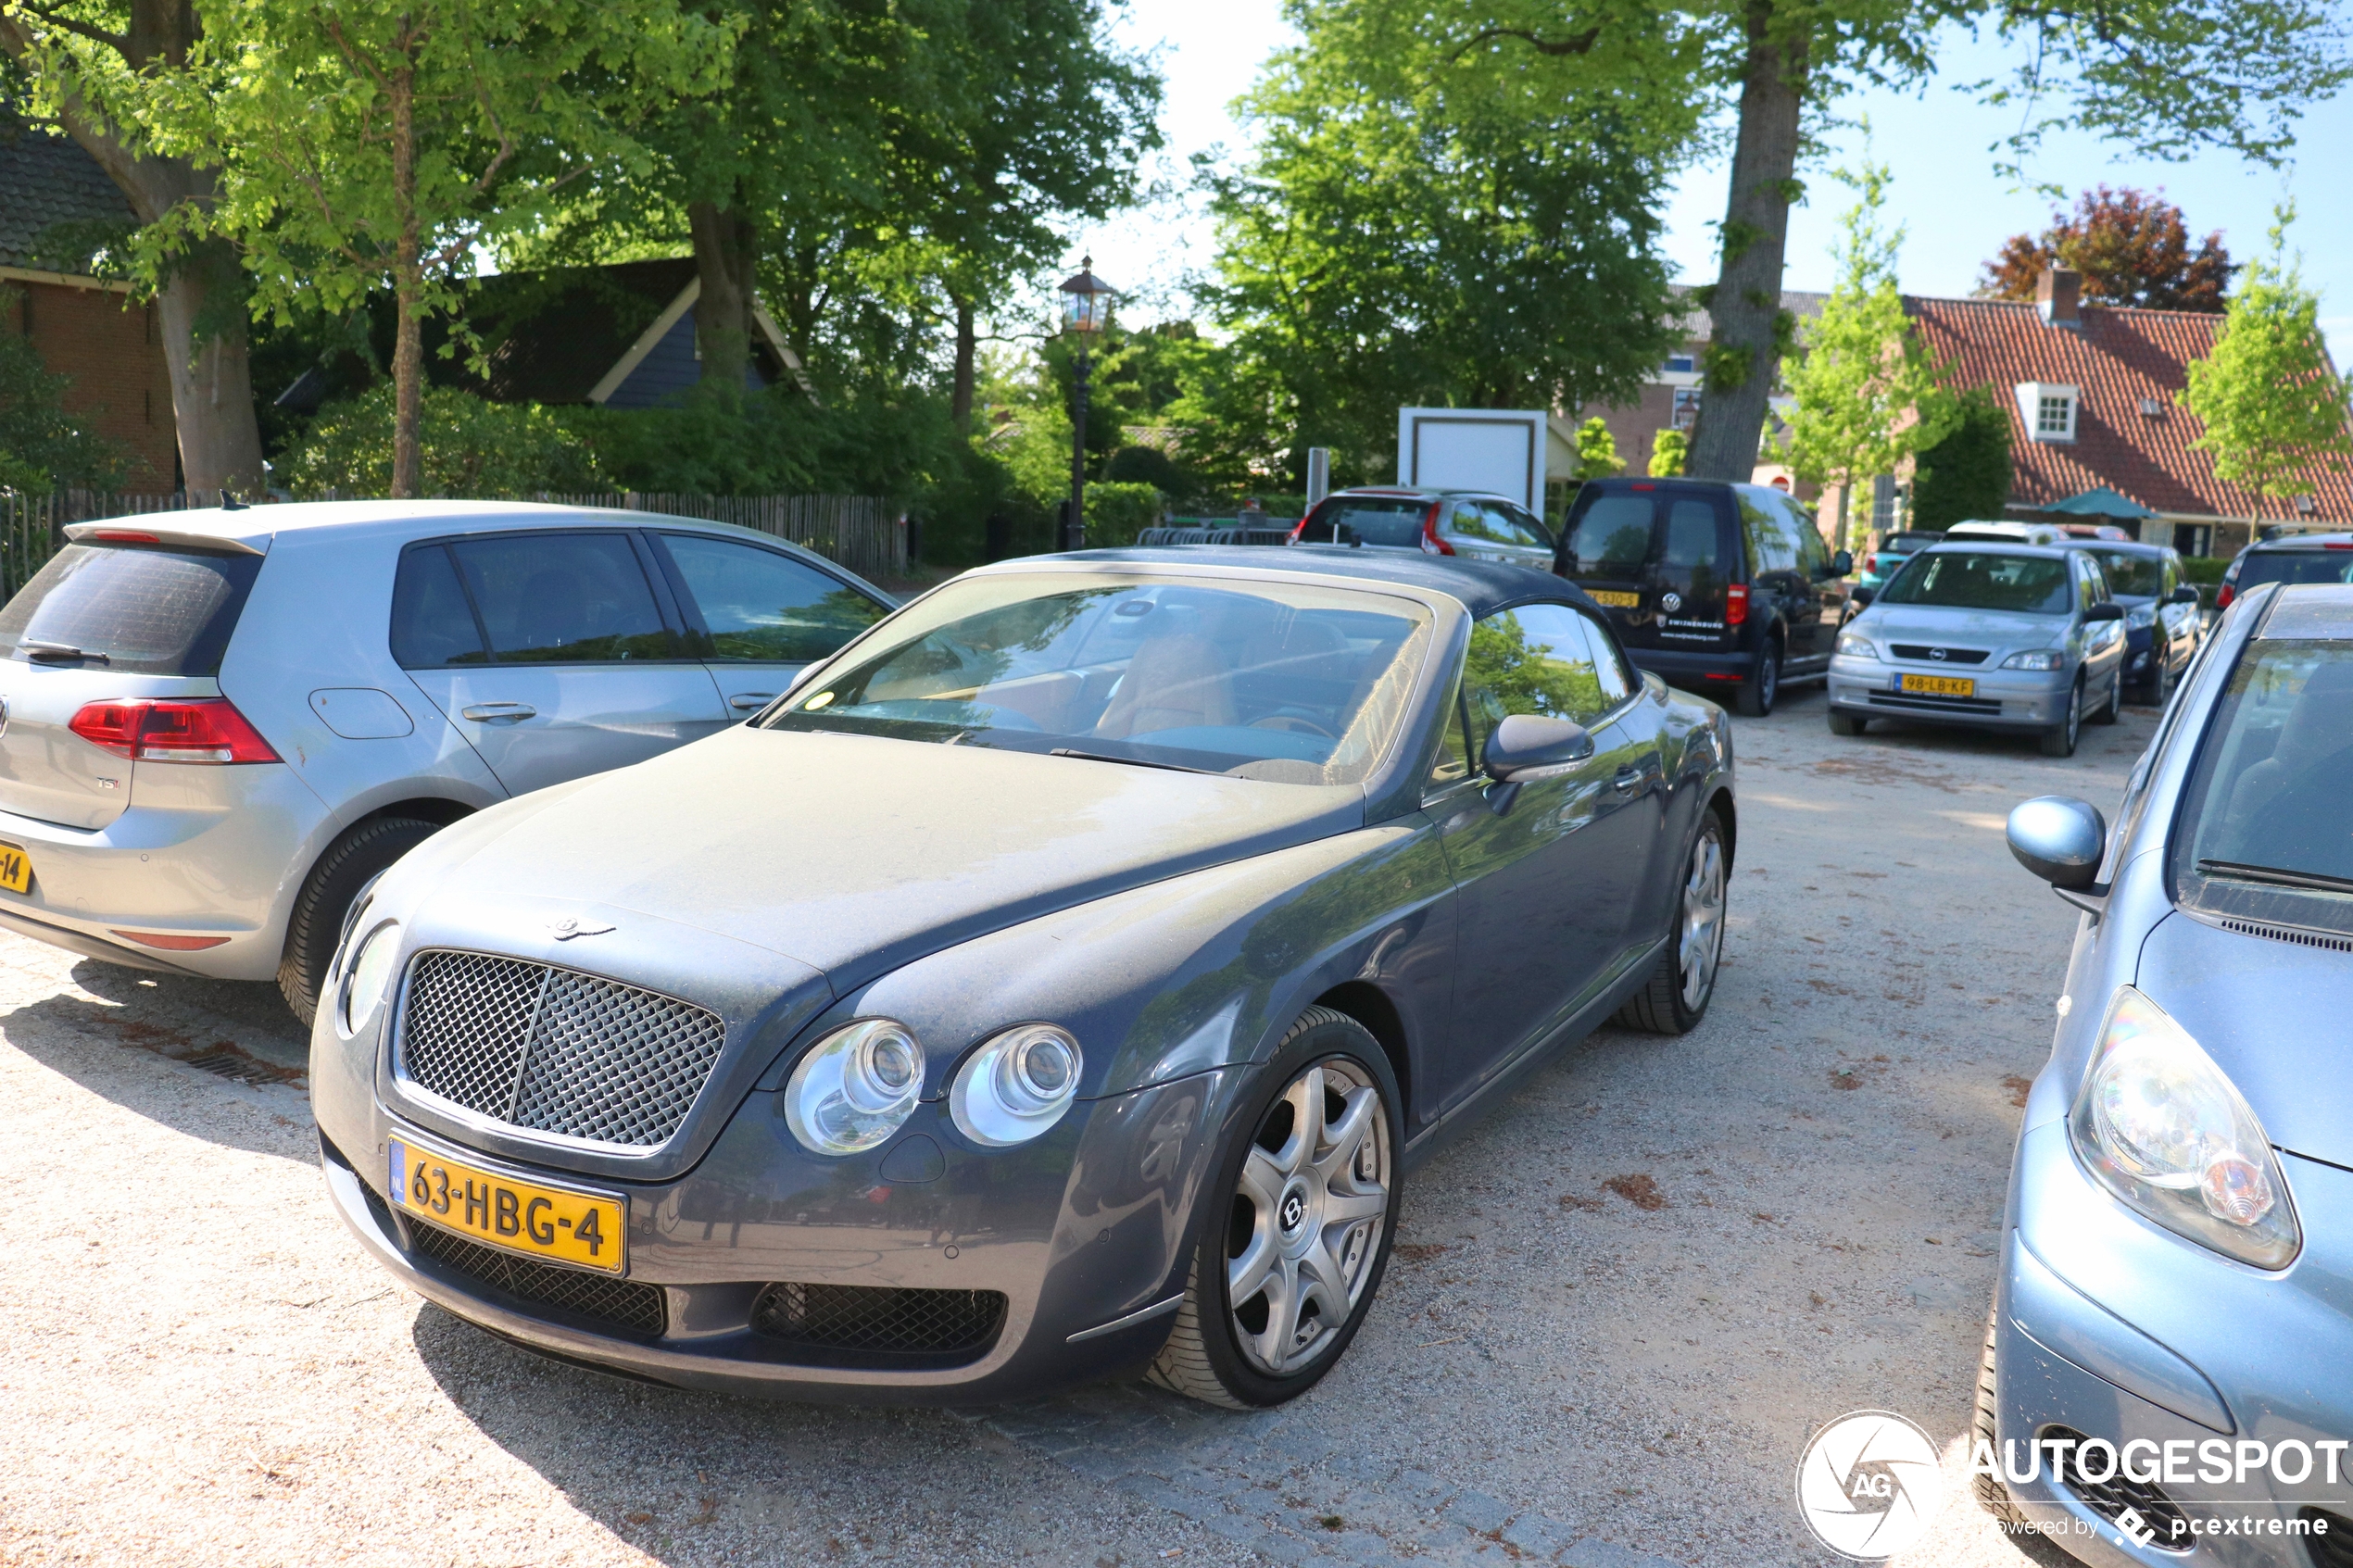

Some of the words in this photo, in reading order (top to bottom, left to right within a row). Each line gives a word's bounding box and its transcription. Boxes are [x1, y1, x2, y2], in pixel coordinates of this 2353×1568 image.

[1589, 592, 1633, 606] X-530-S
[1668, 619, 1724, 629] SWIJNENBURG
[1906, 676, 1969, 693] 98-LB-KF
[96, 776, 120, 789] TSI
[392, 1175, 403, 1193] NL
[411, 1160, 604, 1256] 63-HBG-4
